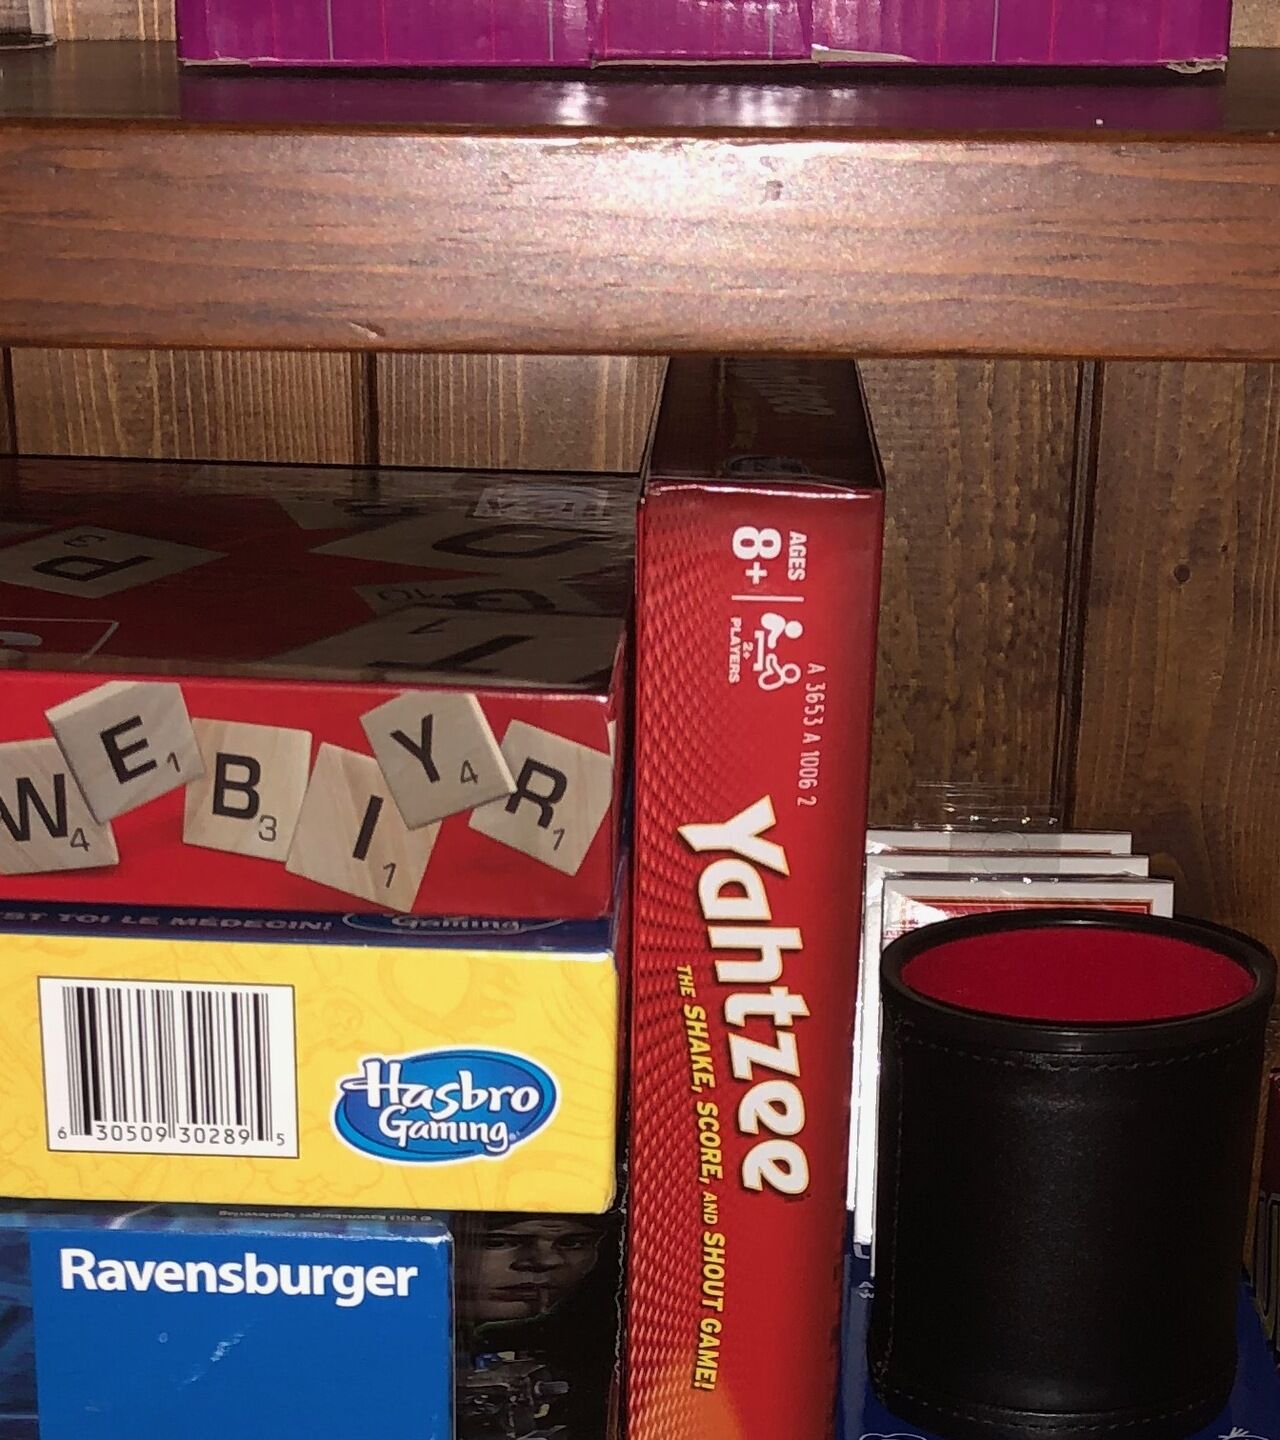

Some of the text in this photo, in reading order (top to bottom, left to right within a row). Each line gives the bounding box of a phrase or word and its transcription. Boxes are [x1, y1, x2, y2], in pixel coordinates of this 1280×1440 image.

[731, 525, 782, 585] 8+
[786, 530, 808, 582] AGES
[728, 616, 743, 685] PLAYERS
[101, 715, 158, 783] E
[389, 714, 442, 785] Y
[796, 662, 827, 807] A 3653 A 1006 2
[211, 753, 262, 820] B
[508, 755, 569, 826] R
[677, 794, 811, 1196] Yahtzee
[342, 1060, 540, 1121] Hasbro
[56, 1124, 288, 1148] 6 30509 30289 5
[378, 1103, 512, 1154] Gaming
[677, 964, 726, 1391] THE SHAKE, SCORE, AND SHOUT GAME!
[59, 1247, 419, 1308] Ravensburger
